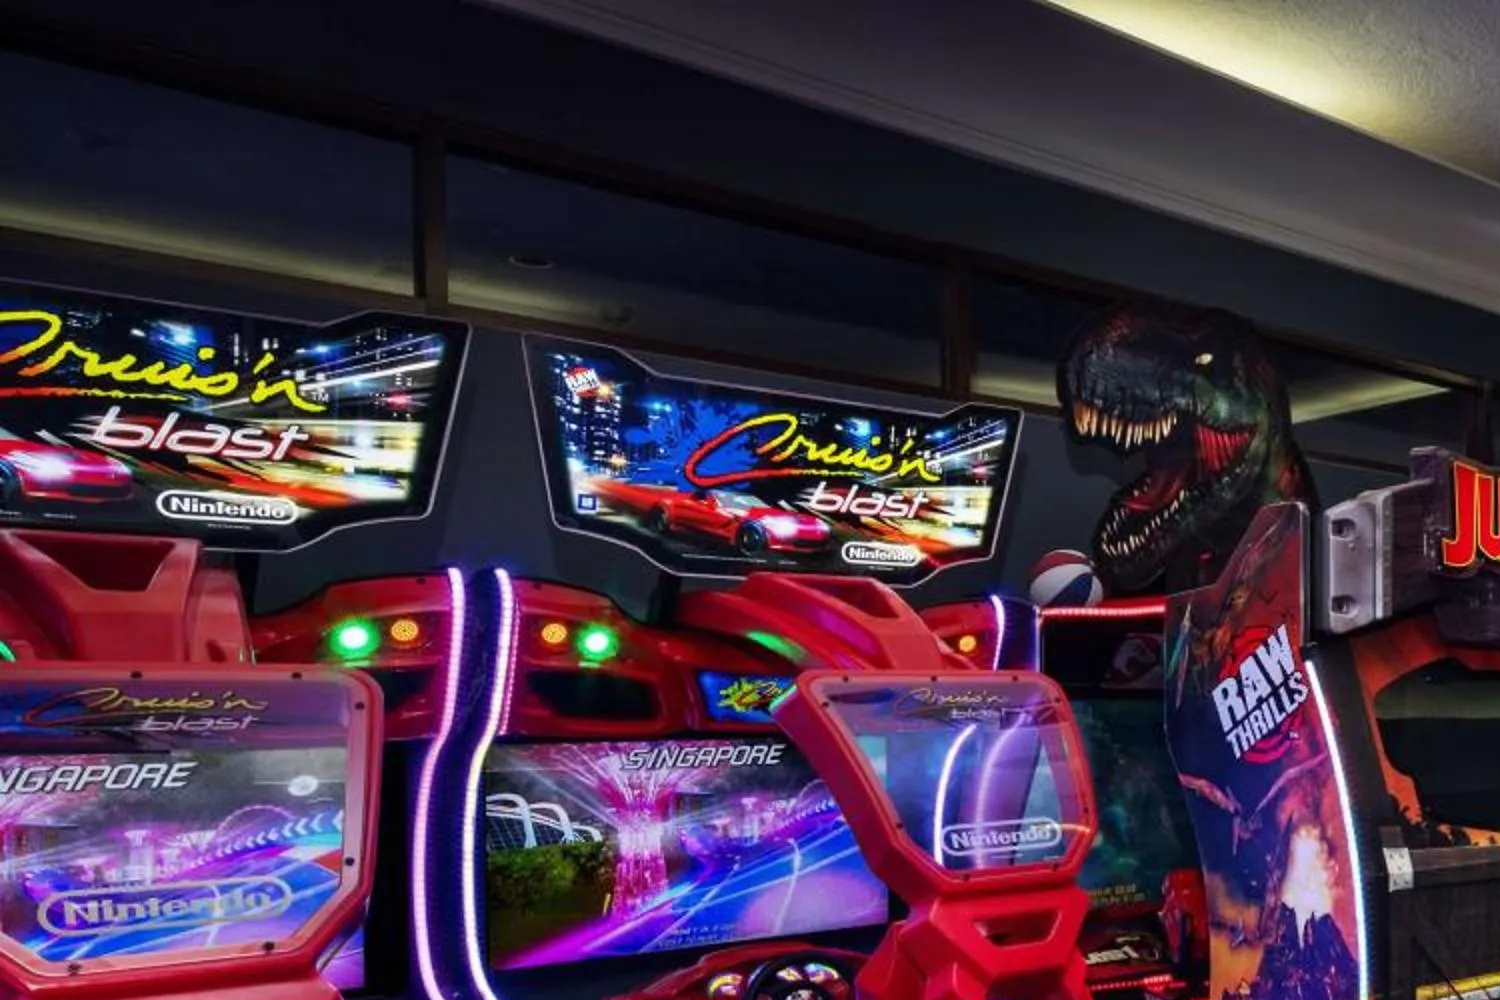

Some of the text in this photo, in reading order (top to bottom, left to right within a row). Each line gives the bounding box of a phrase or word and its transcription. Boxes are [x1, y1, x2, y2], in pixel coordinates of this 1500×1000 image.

[84, 405, 312, 461] blast
[684, 412, 943, 487] Cruis'n
[169, 495, 288, 520] Nintendo
[805, 481, 929, 519] blast
[847, 545, 916, 563] Nintendo
[1212, 623, 1296, 732] RAW
[24, 687, 268, 727] Cruis'n
[134, 714, 260, 731] blast
[1226, 671, 1309, 759] THRILLS
[621, 744, 787, 770] SINGAPORE
[951, 825, 1051, 849] Nintendo
[62, 887, 275, 931] Nintendo
